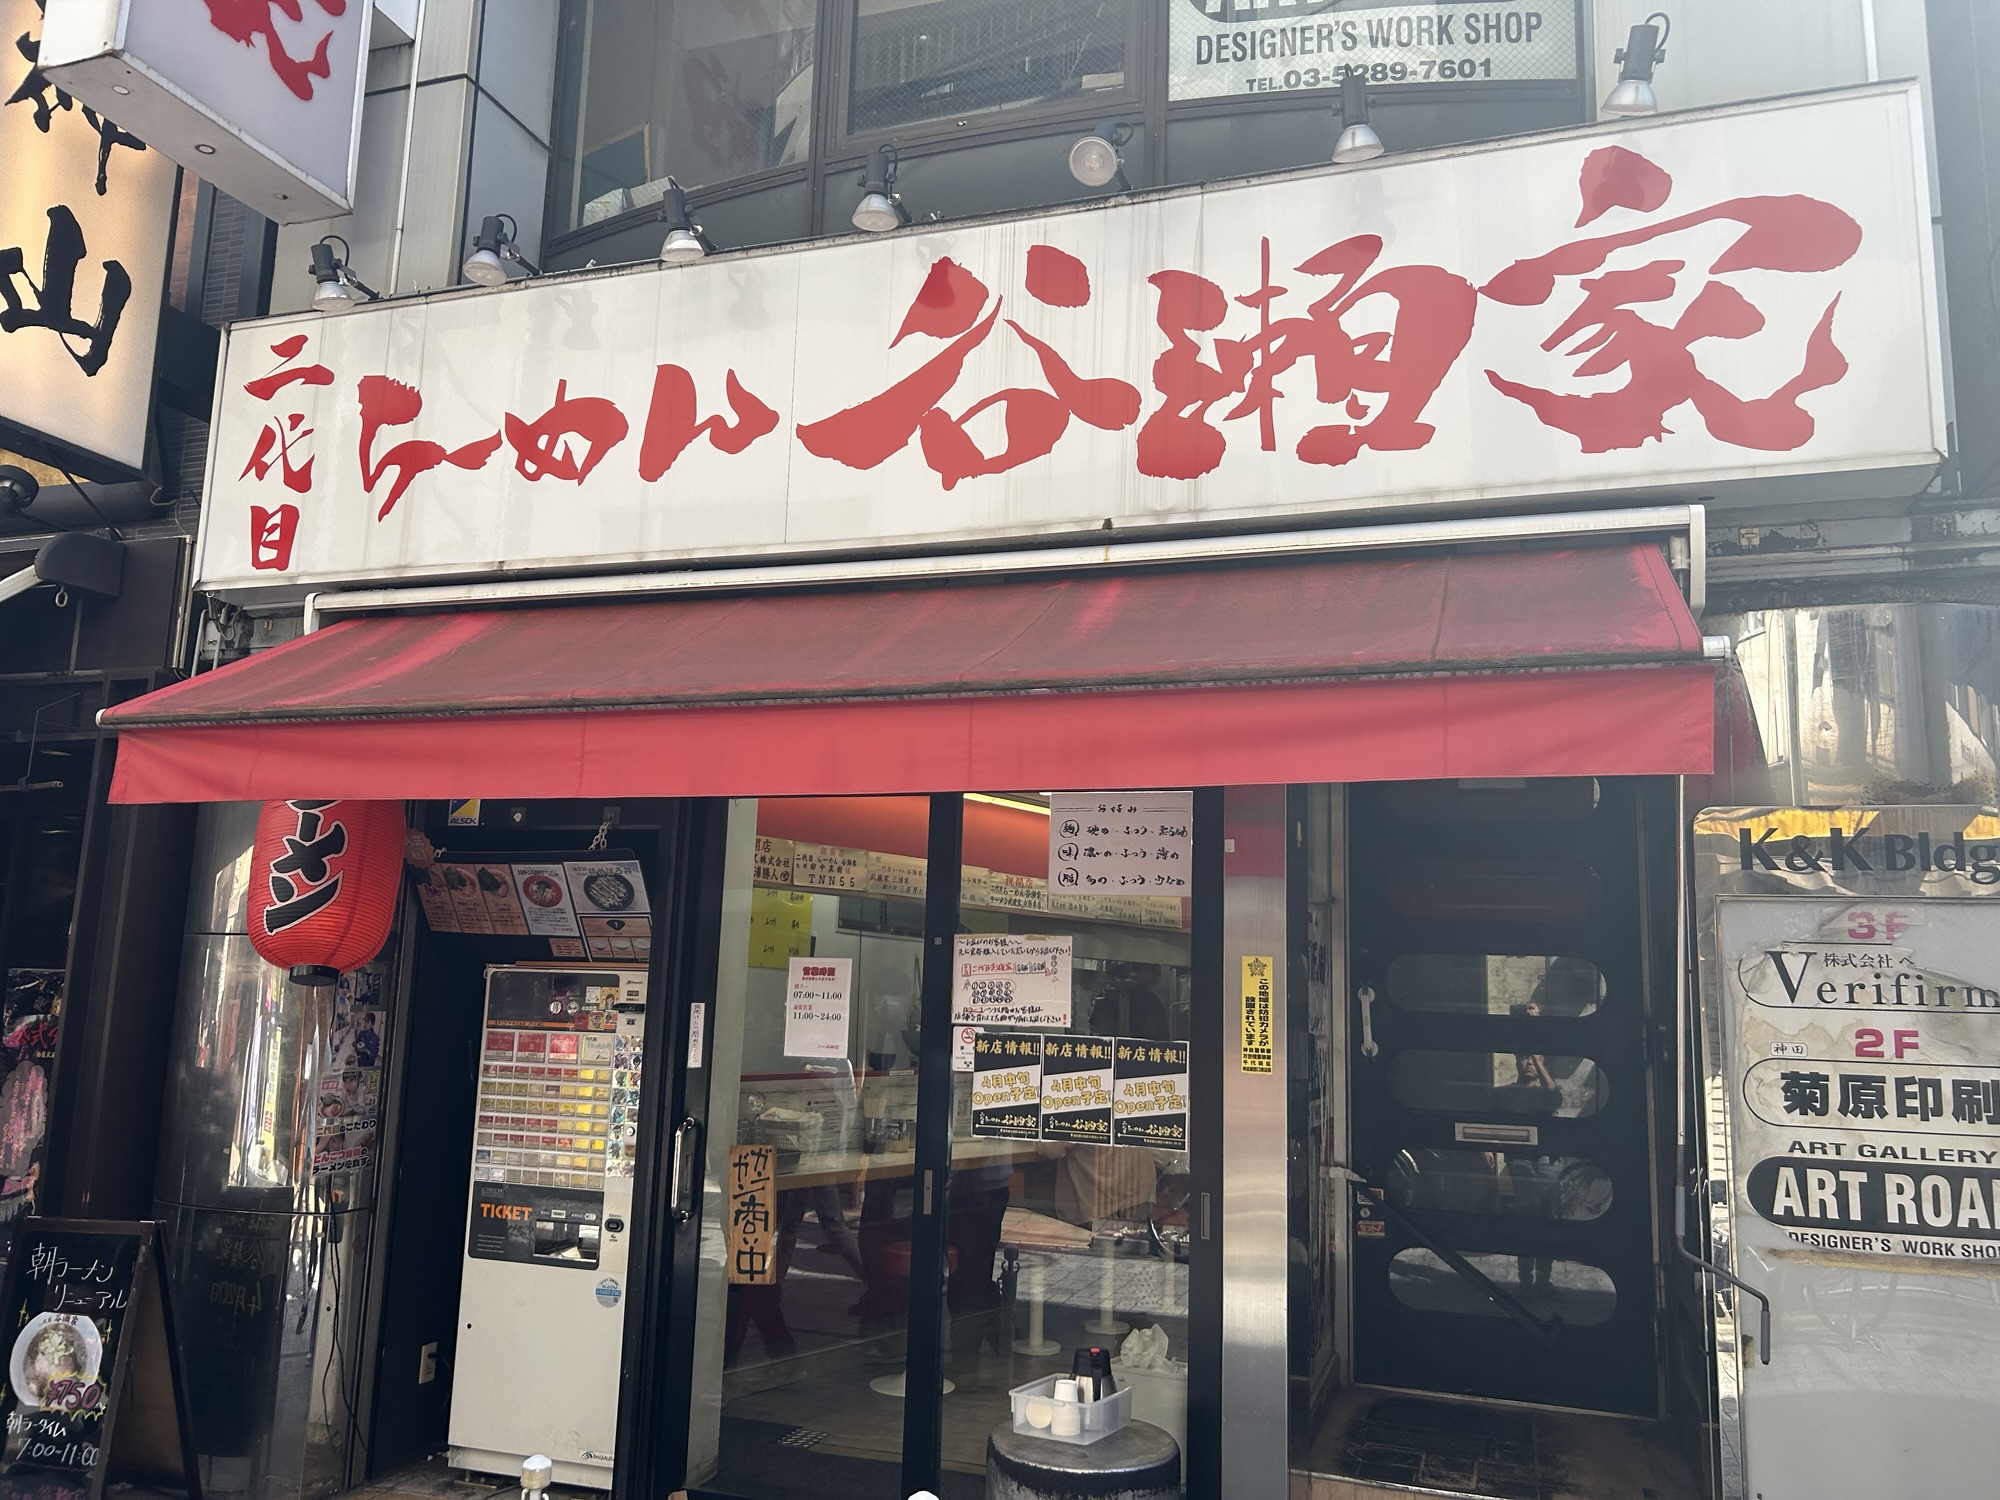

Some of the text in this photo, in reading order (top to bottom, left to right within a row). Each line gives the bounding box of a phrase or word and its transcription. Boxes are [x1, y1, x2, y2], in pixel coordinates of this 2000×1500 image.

[1367, 14, 1454, 49] WORK
[1464, 11, 1542, 45] SHOP
[239, 334, 335, 571] 二代目
[1097, 804, 1137, 813] お好み
[450, 817, 476, 825] ALSOK
[1774, 1043, 1804, 1055] 神田
[1855, 1028, 1919, 1059] 2F
[982, 1071, 1030, 1088] 4月中旬
[1051, 1075, 1101, 1092] 4月中旬
[1124, 1080, 1175, 1096] 4月中旬
[1780, 1071, 2000, 1125] 菊原印刷
[1788, 1140, 1998, 1164] ART GALLERY
[1773, 1166, 2000, 1230] ART ROA
[480, 1203, 533, 1221] TICKET
[1902, 1240, 1956, 1257] WORK
[1961, 1244, 2000, 1259] SHO
[26, 1242, 113, 1285] 朝ラーメン
[54, 1283, 127, 1311] リニューアル
